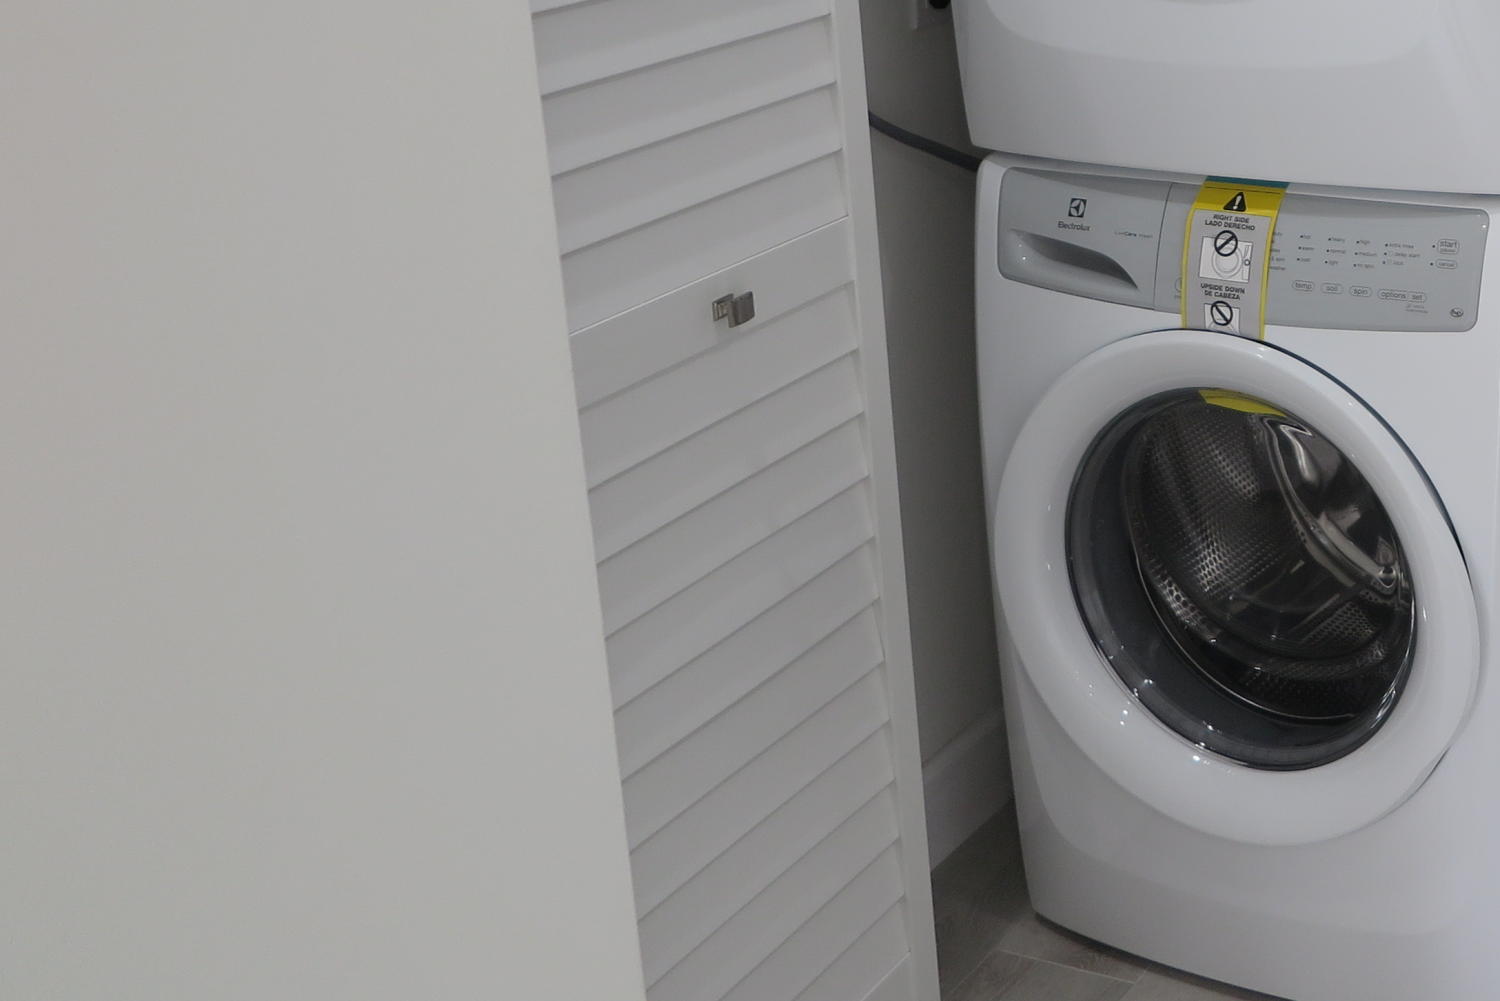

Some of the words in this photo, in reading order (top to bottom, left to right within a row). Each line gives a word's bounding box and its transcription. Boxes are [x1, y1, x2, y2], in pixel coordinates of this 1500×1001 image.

[1213, 214, 1233, 222] RIGHT
[1057, 220, 1091, 231] Electrolux
[1205, 219, 1223, 227] LADO
[1223, 221, 1256, 231] DERECHO
[1200, 283, 1223, 292] UPSIDE
[1225, 285, 1245, 294] DOWN
[1295, 282, 1312, 291] temp
[1204, 289, 1213, 297] DE
[1214, 291, 1241, 300] CABEZA
[1353, 288, 1369, 297] spin
[1380, 291, 1406, 300] options
